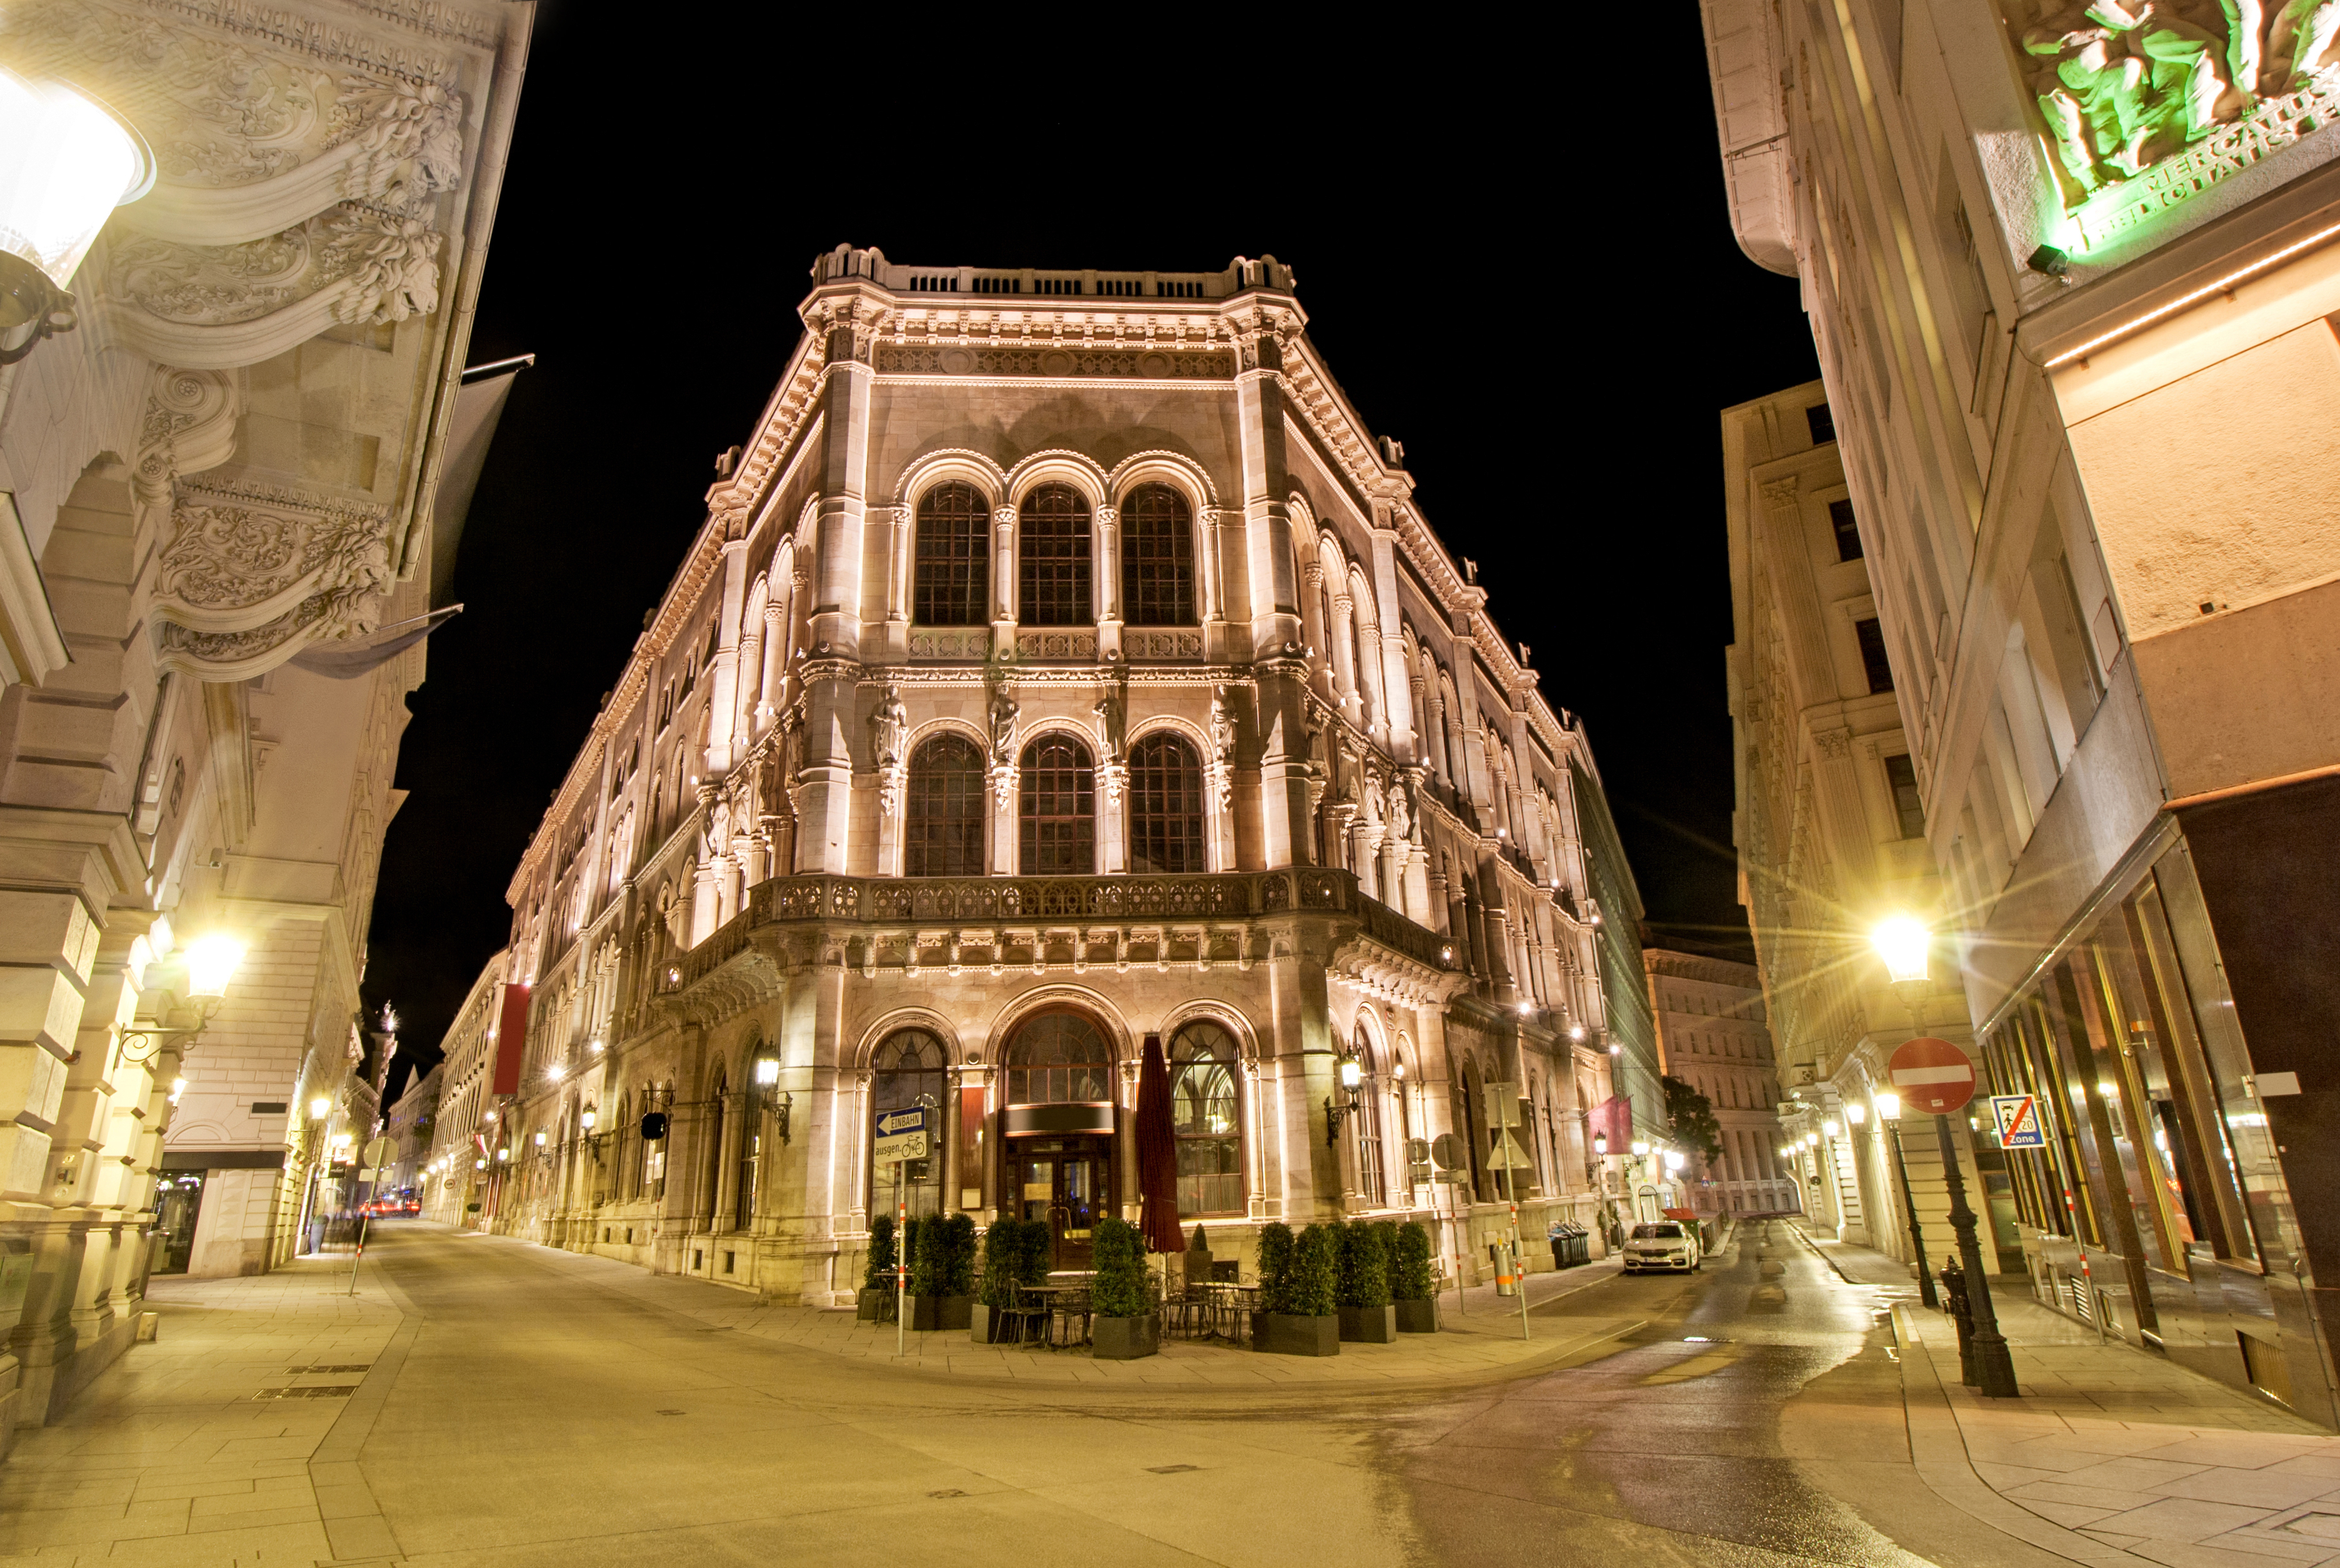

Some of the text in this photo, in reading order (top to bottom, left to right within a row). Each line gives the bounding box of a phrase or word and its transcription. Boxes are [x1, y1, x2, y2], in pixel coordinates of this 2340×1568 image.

[892, 1114, 919, 1129] EINBAHN
[2021, 1121, 2033, 1130] 20
[2010, 1136, 2036, 1144] Zone
[876, 1144, 901, 1156] ausgen.
